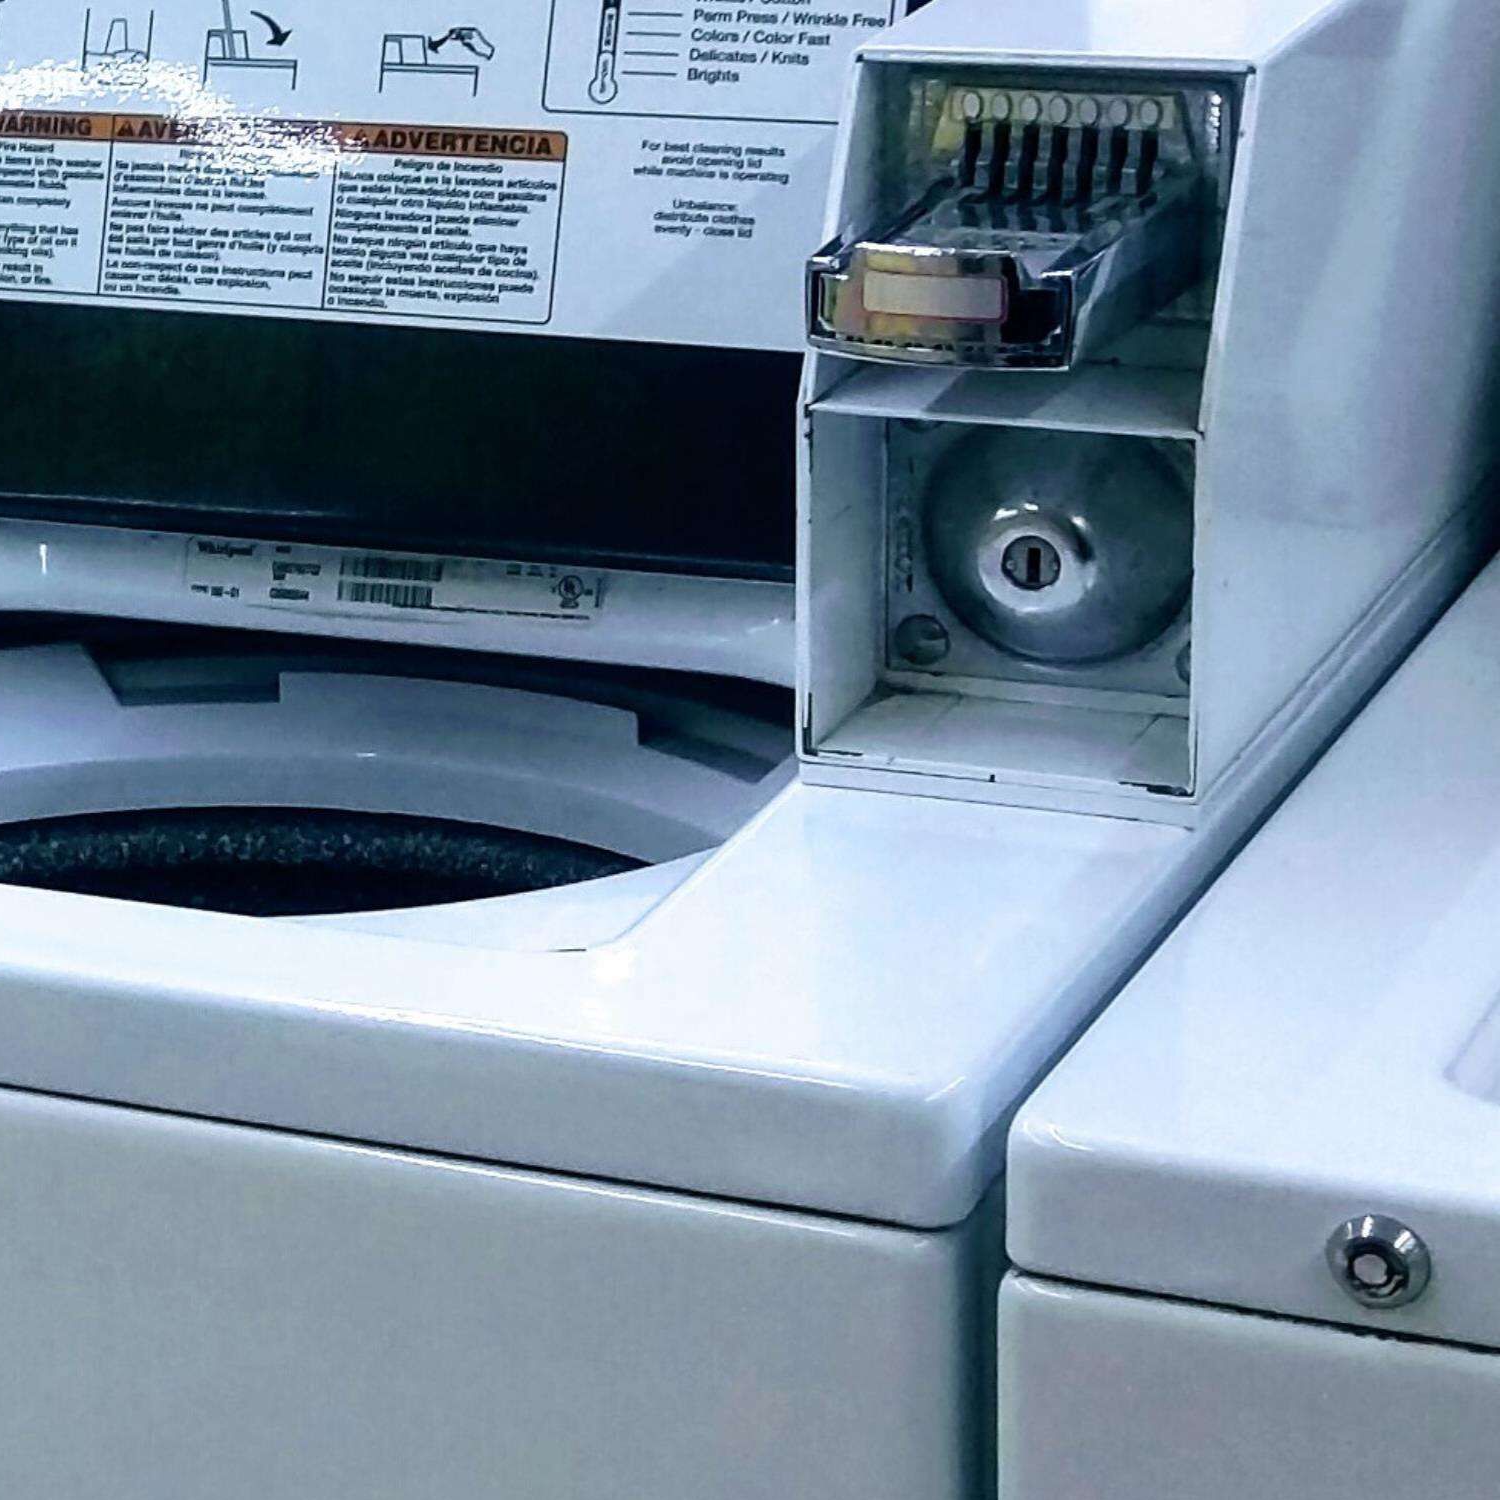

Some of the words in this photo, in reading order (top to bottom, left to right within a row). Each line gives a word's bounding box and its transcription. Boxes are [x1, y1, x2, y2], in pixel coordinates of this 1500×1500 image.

[694, 9, 732, 23] Perm
[737, 11, 778, 25] Press
[792, 12, 848, 27] Wrinkle
[852, 14, 886, 28] Free
[691, 29, 739, 43] Colors
[753, 31, 793, 45] Color
[798, 32, 831, 46] Fast
[689, 49, 758, 64] Delicates
[772, 51, 810, 65] Knits
[687, 68, 740, 86] Brights
[372, 129, 552, 155] ADVERTENCIA
[664, 142, 690, 153] best
